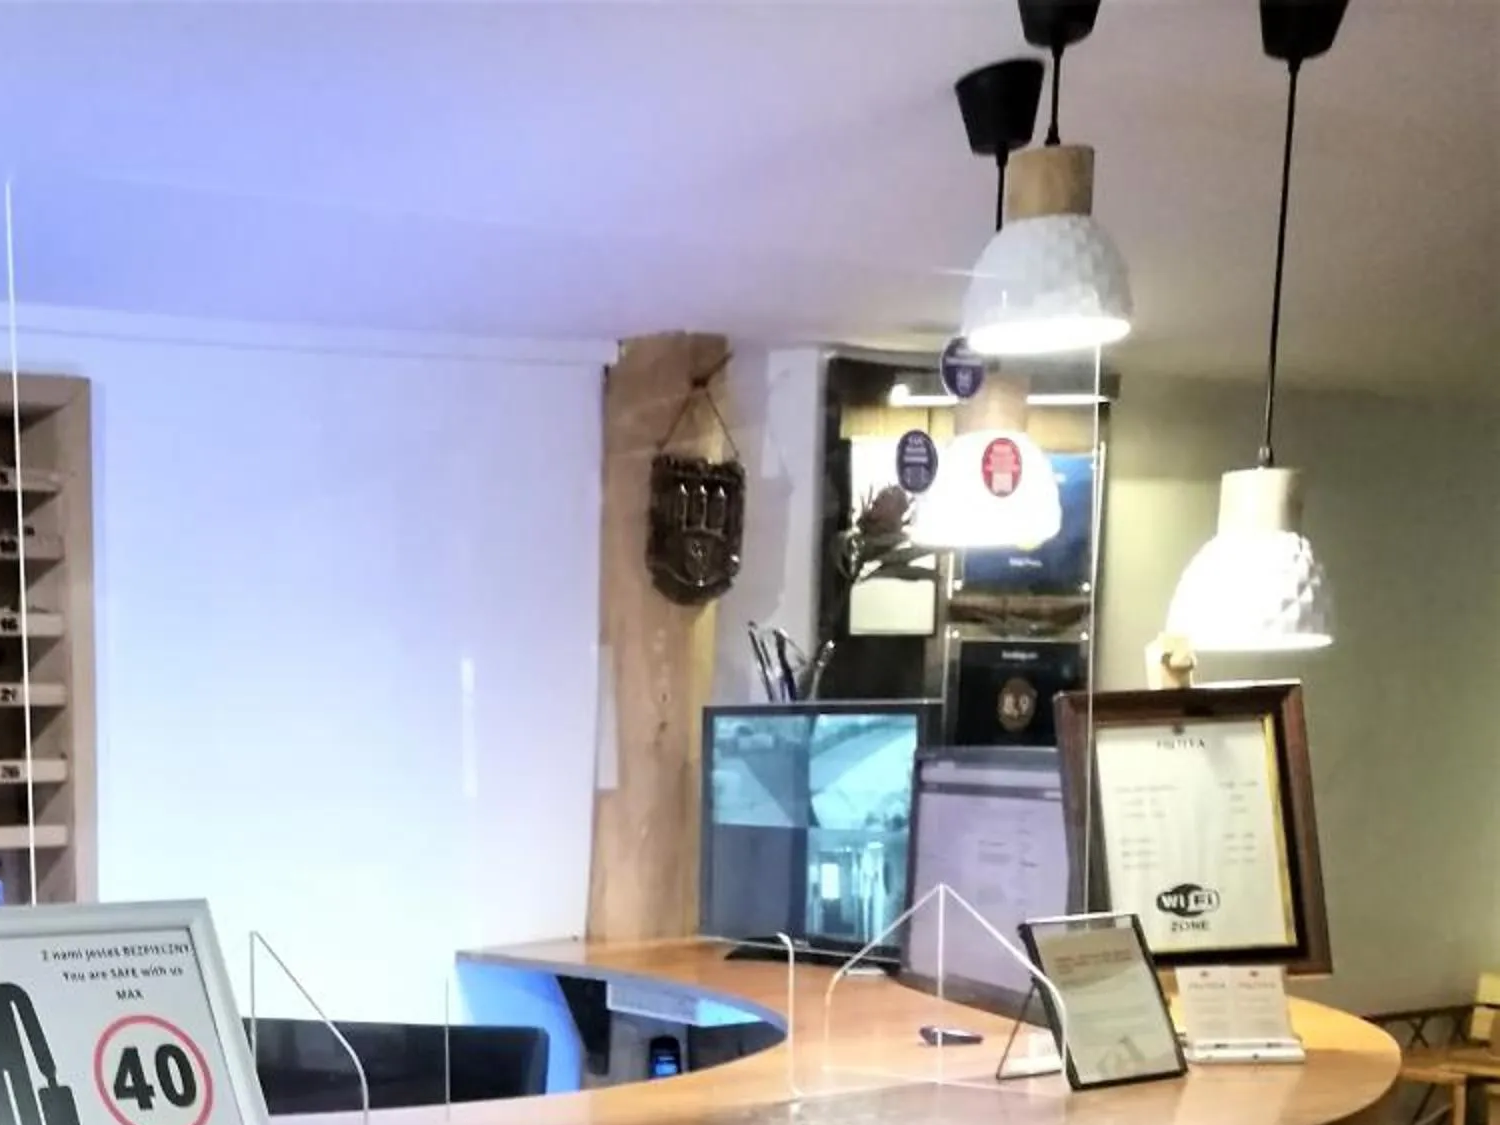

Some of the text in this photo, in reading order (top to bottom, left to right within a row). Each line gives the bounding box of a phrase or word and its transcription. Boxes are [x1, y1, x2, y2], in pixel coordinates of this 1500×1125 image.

[62, 965, 183, 982] You are SAFE with us
[115, 988, 144, 1000] MAX
[113, 1043, 197, 1111] 40
